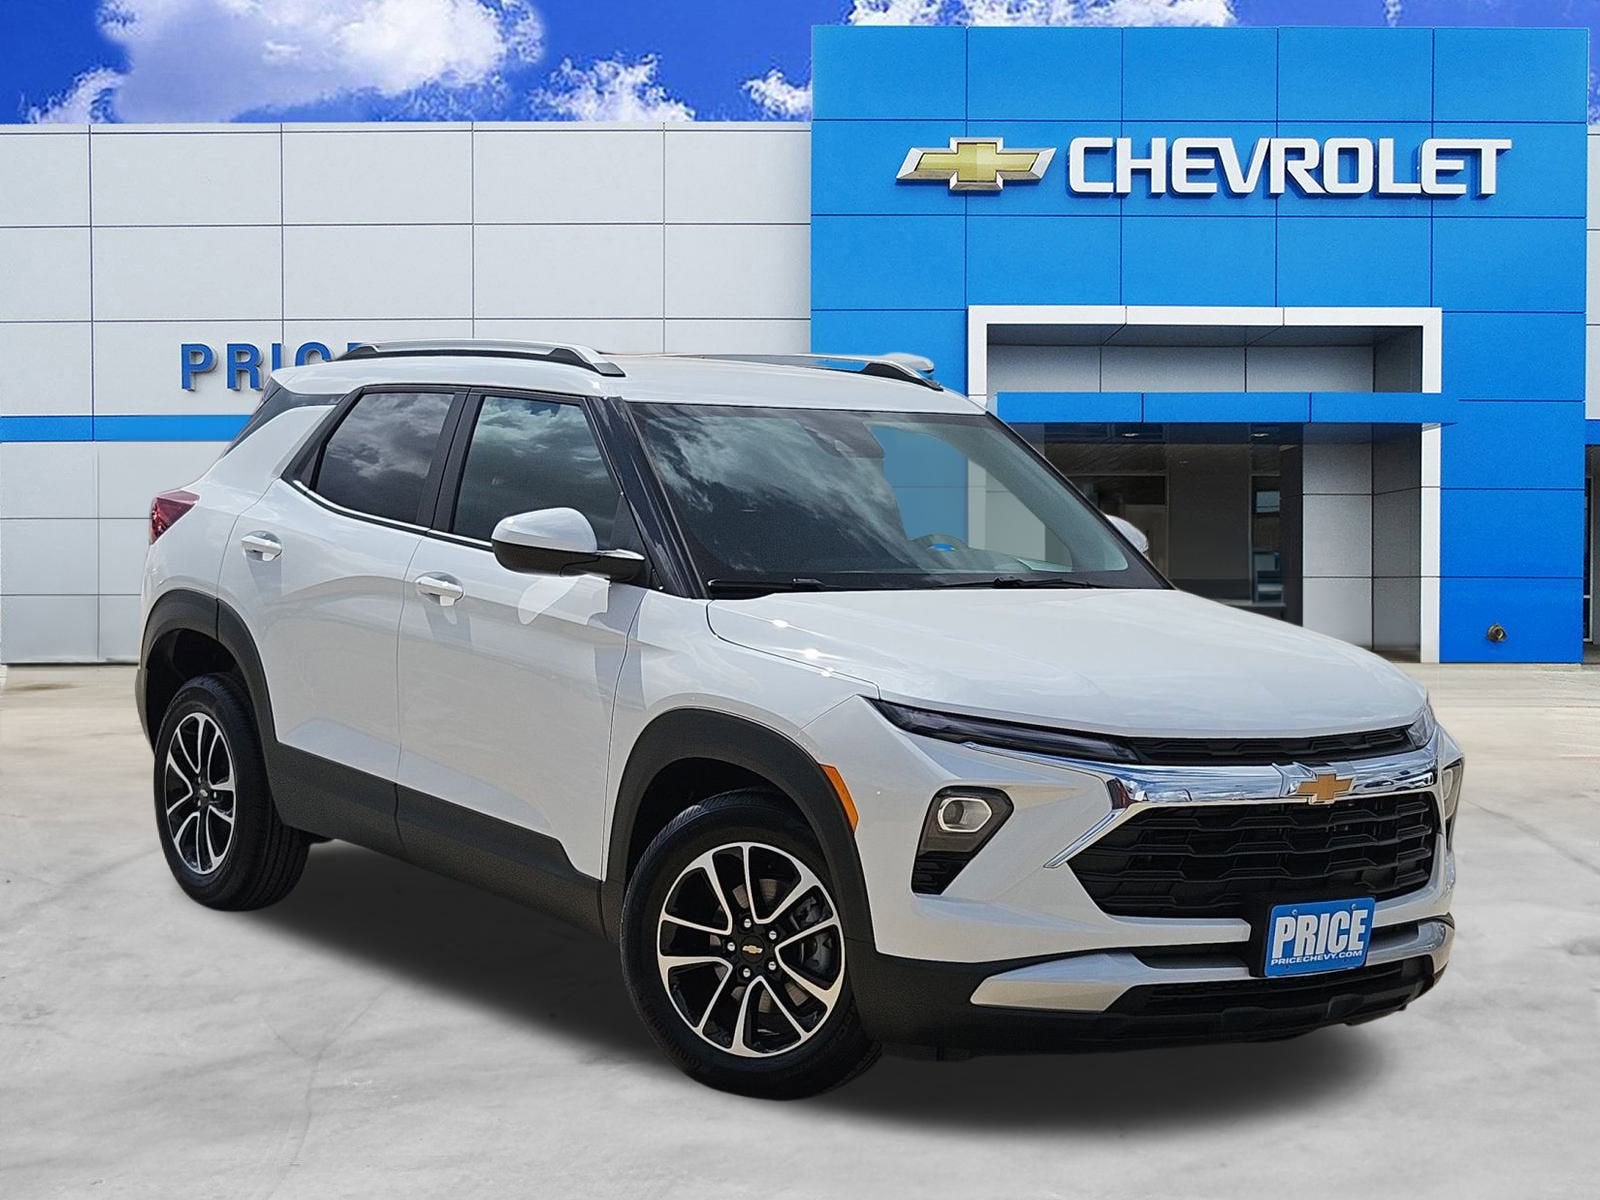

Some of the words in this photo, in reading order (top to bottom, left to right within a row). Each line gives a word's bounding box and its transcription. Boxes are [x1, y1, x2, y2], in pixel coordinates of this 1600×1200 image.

[1069, 136, 1512, 195] CHEVROLET
[181, 341, 367, 391] PRIC
[1270, 950, 1363, 967] PRICECHEVY.COM
[1271, 909, 1369, 959] PRICE
